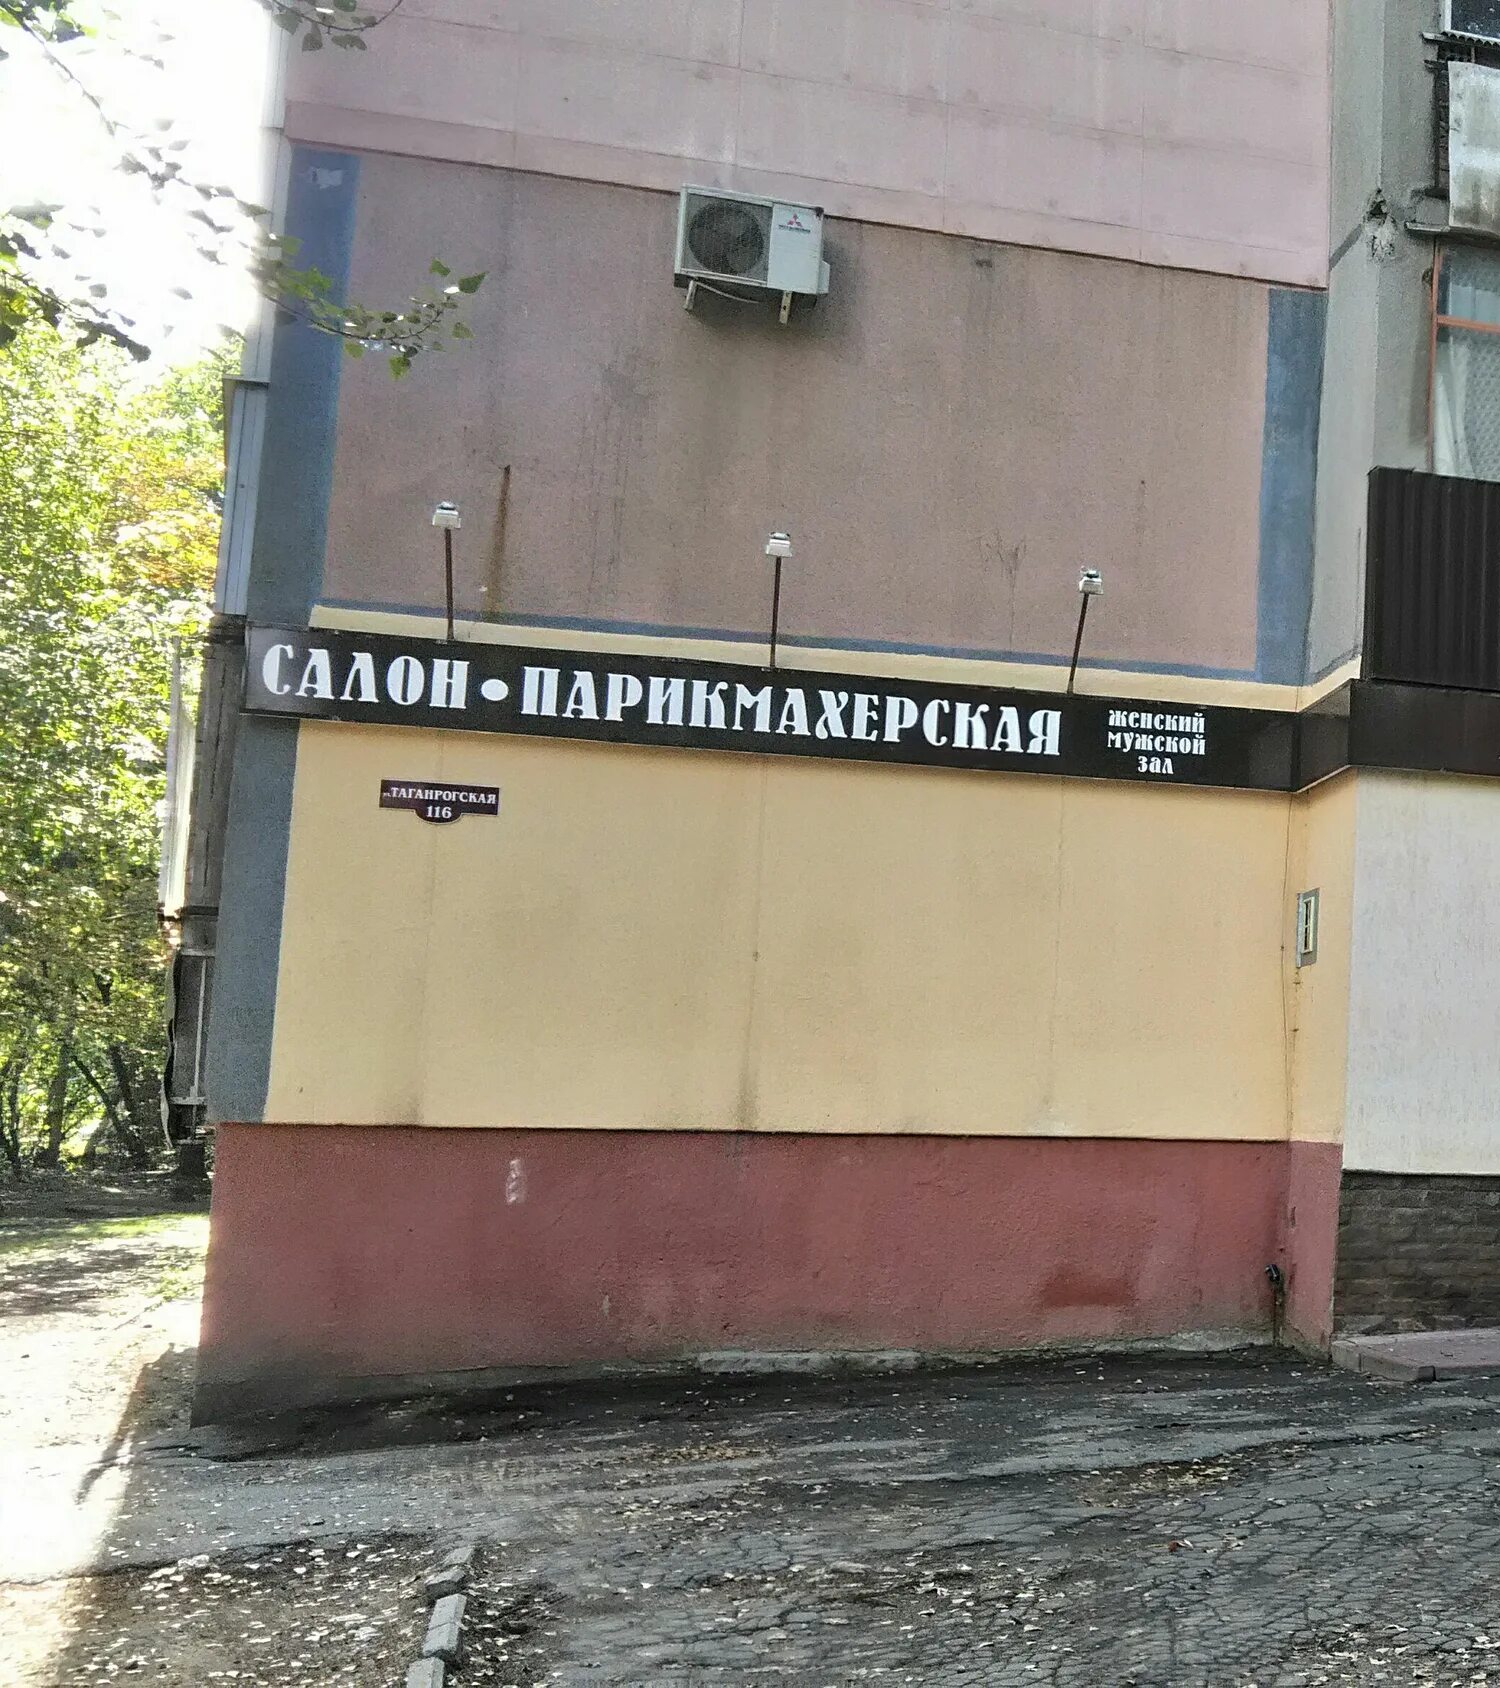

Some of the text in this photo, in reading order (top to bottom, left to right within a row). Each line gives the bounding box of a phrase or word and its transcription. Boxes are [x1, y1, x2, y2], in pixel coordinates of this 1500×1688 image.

[261, 643, 1062, 757] САЛОН ПАРИКМАХЕРСКАЯ
[391, 787, 497, 804] ТАГАНРОГСКАЯ
[426, 805, 452, 819] 116
